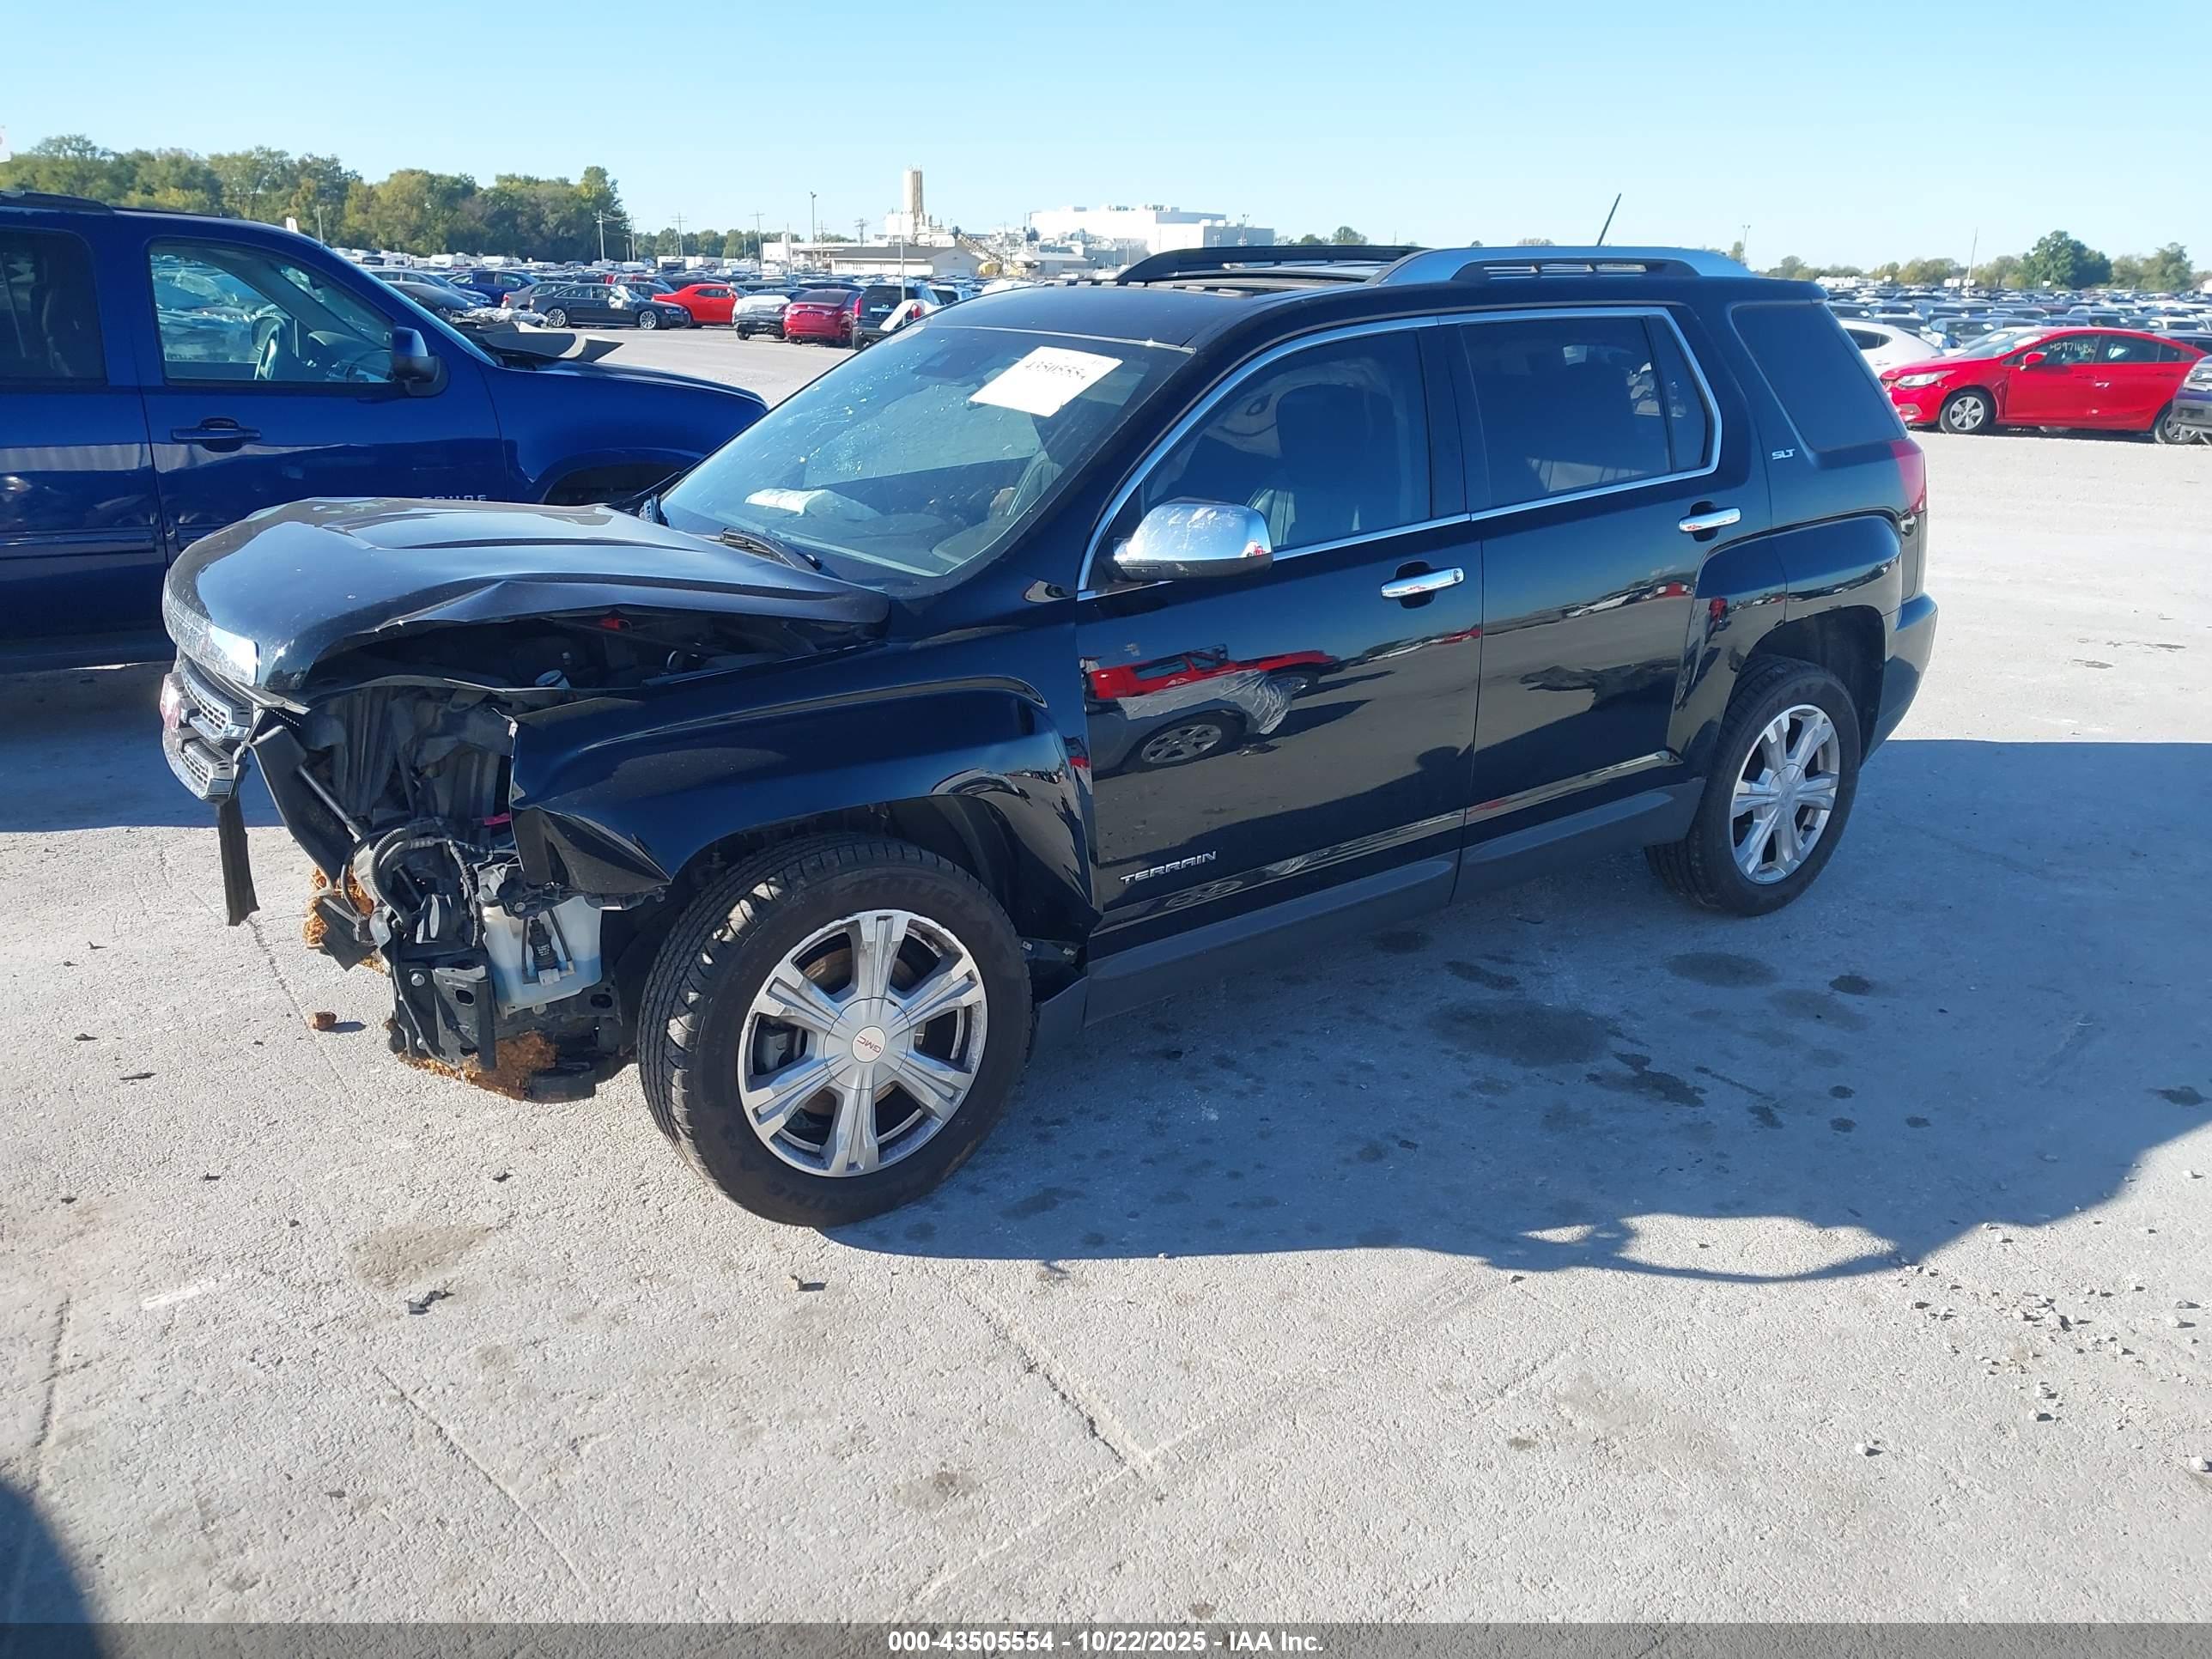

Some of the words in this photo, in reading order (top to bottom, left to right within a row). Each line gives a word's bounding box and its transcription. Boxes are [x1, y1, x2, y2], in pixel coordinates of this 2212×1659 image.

[1771, 448, 1796, 460] SLT
[1120, 850, 1217, 885] TERRAIN
[856, 1036, 882, 1054] GMC
